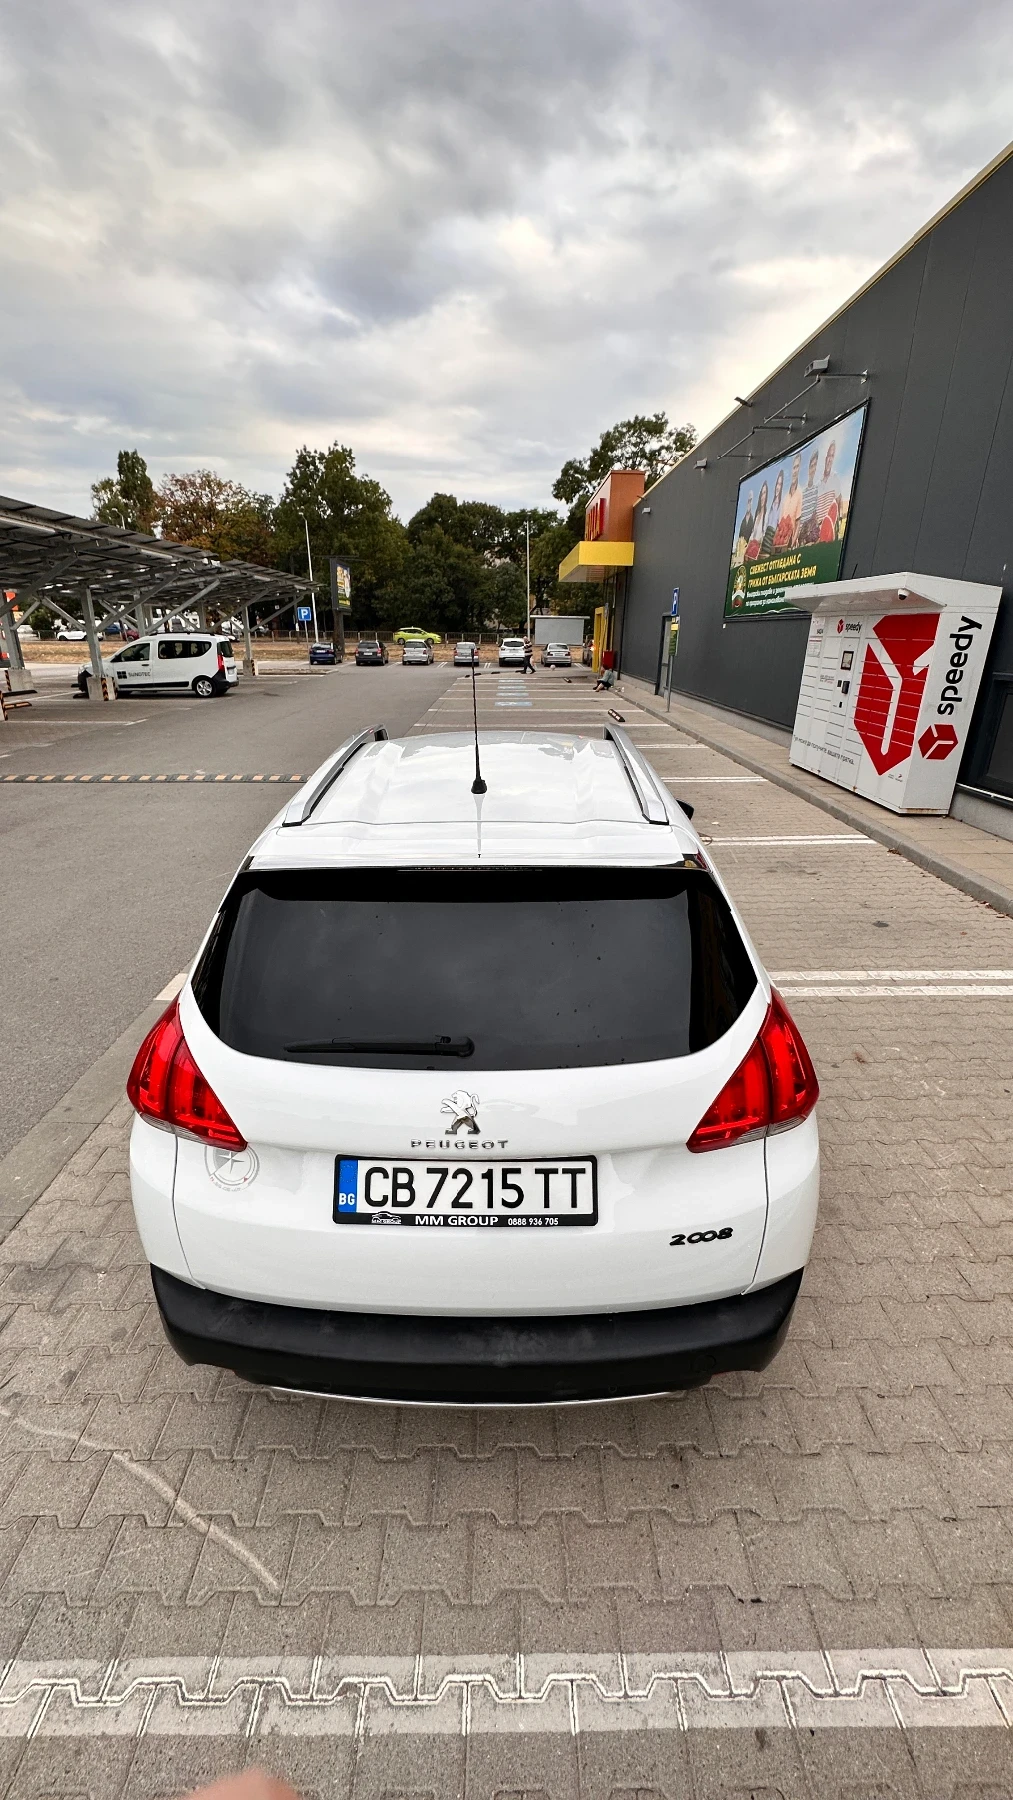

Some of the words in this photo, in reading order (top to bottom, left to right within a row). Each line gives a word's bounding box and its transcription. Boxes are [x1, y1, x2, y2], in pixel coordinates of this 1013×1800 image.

[800, 565, 817, 579] ЗЕМЯ
[301, 609, 309, 619] P
[845, 621, 862, 633] speedy
[937, 615, 982, 715] speedy
[410, 1139, 509, 1149] PEUGEOT
[364, 1166, 416, 1209] CB
[426, 1167, 524, 1209] 7215
[534, 1168, 586, 1209] TT
[338, 1192, 355, 1206] BG
[414, 1215, 445, 1226] MM
[447, 1215, 499, 1227] GROUP
[507, 1217, 527, 1226] 0888
[528, 1217, 543, 1226] 936
[544, 1217, 559, 1226] 705
[669, 1227, 733, 1246] 2008
